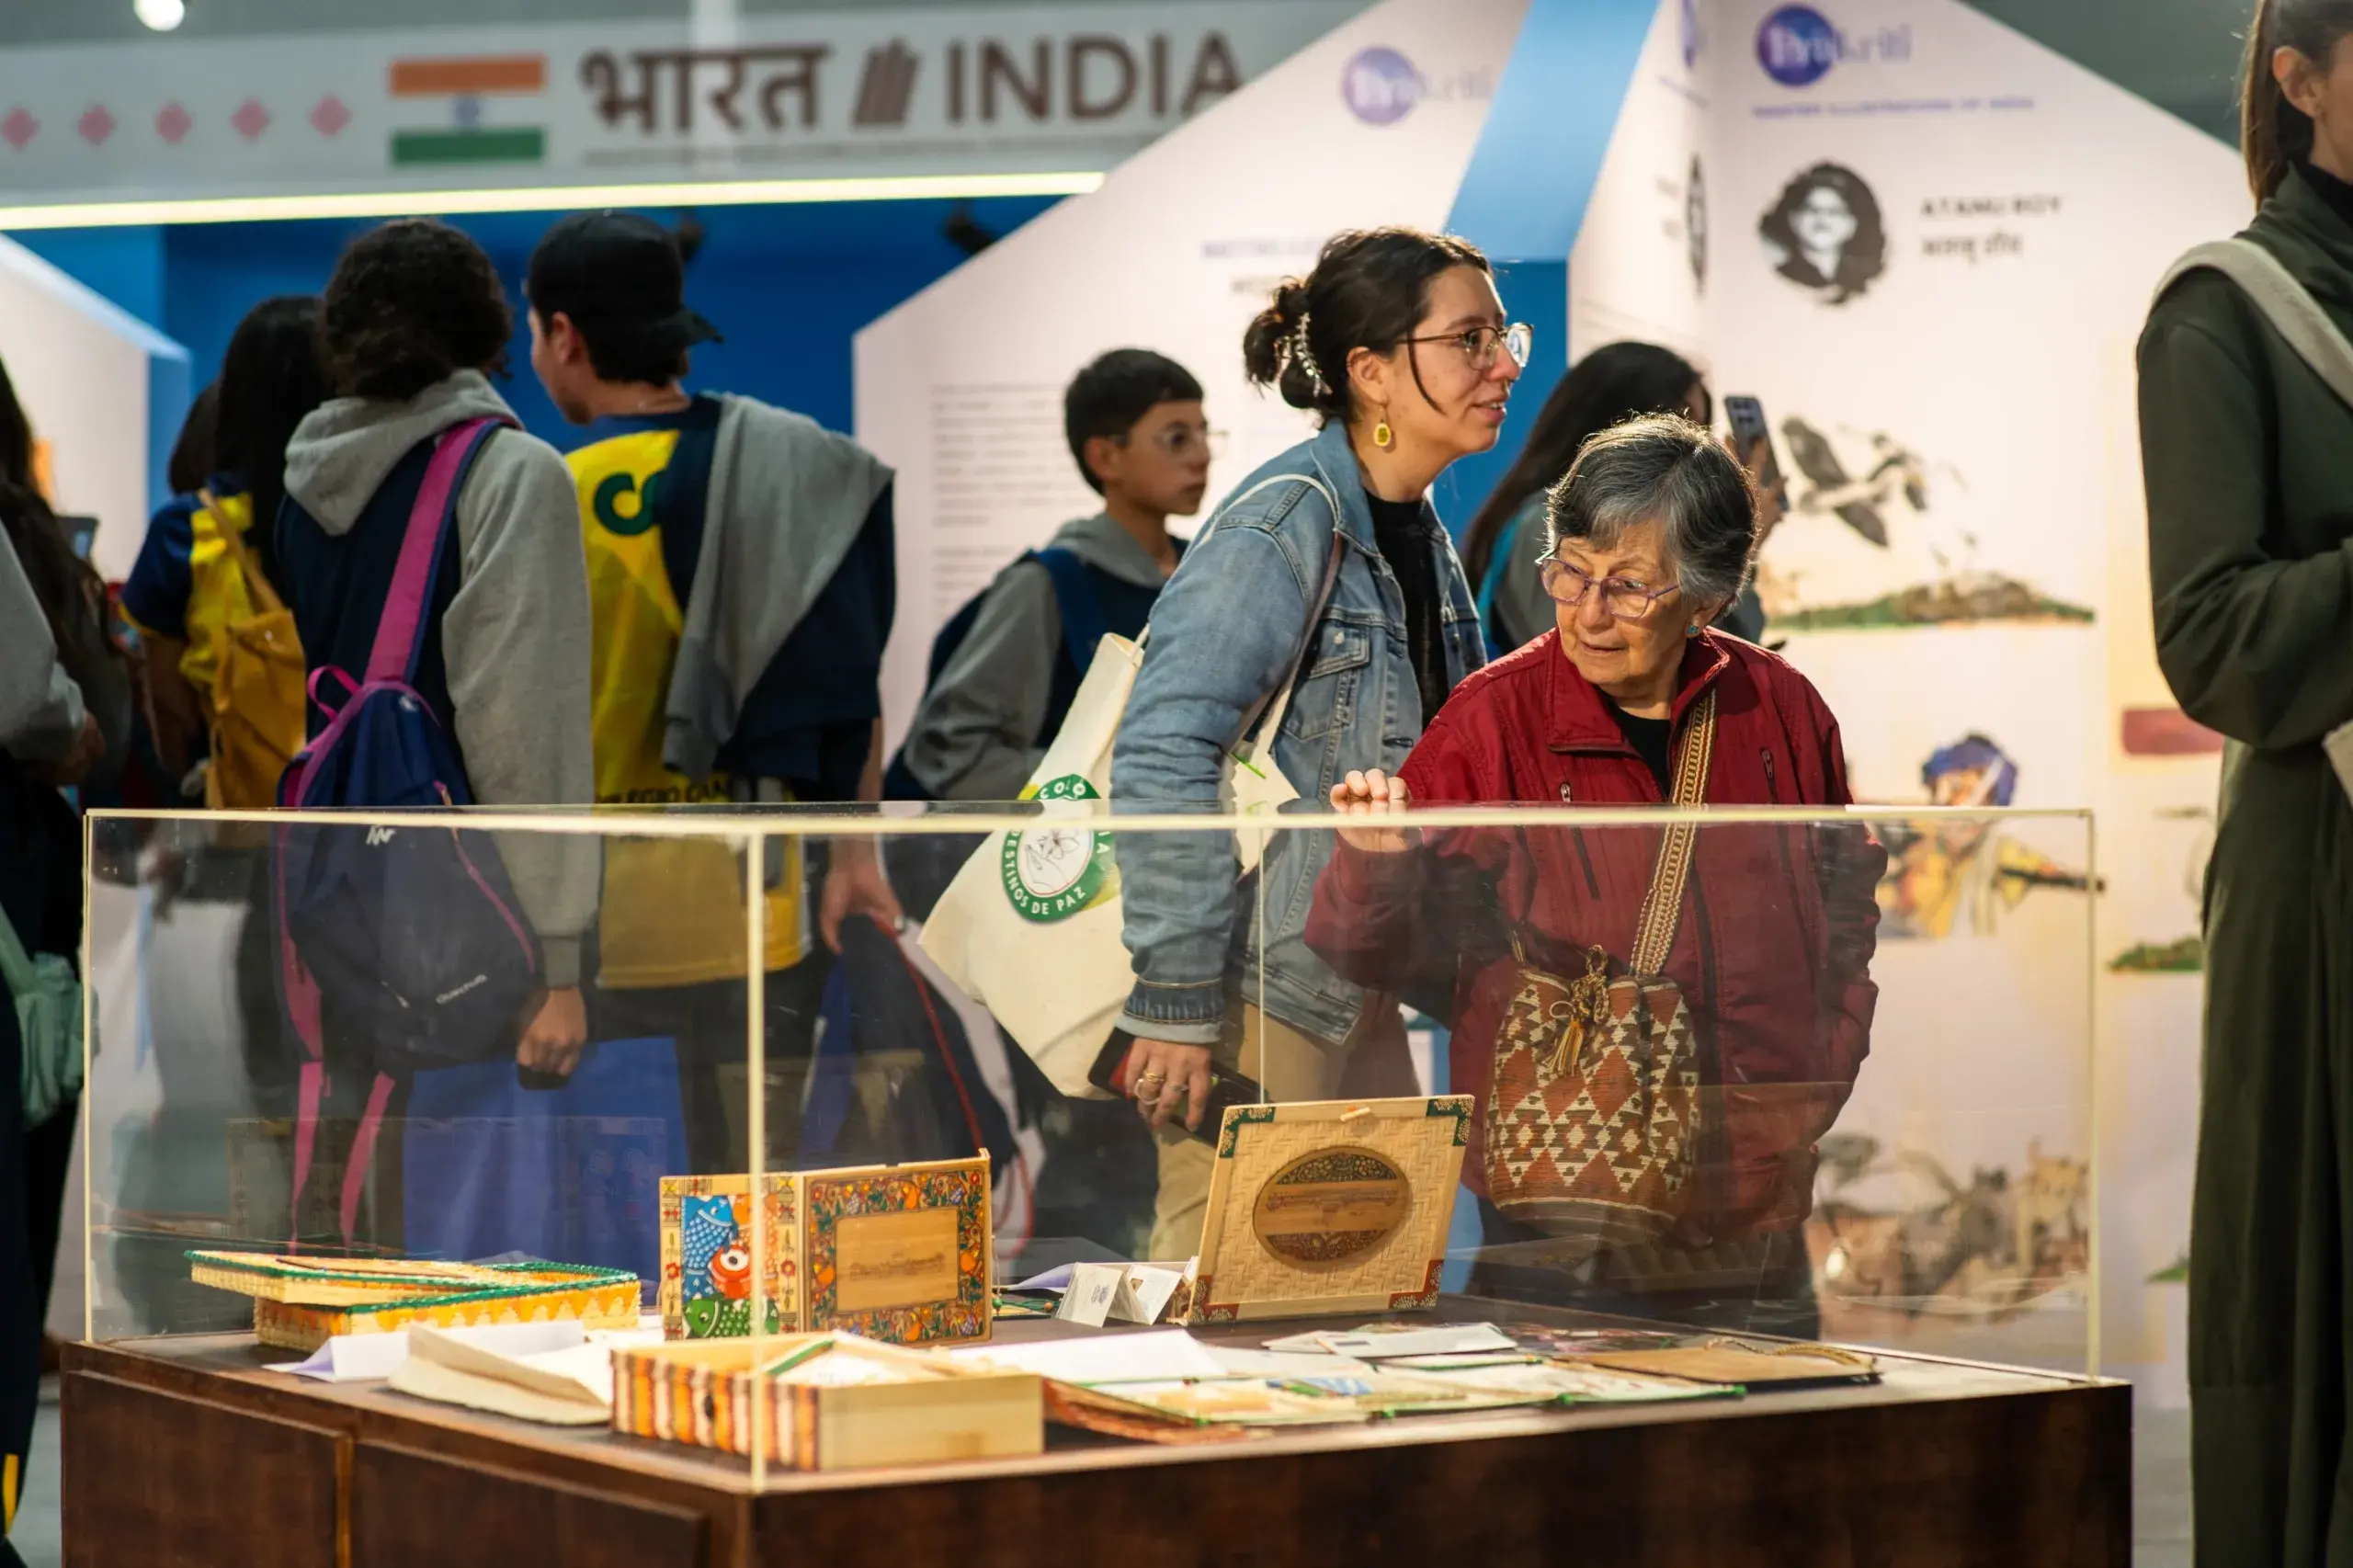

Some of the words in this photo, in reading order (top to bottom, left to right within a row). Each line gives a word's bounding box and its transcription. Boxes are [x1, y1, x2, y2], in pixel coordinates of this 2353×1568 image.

[578, 42, 833, 134] भारत
[947, 30, 1245, 123] INDIA
[1030, 901, 1050, 915] DE
[1056, 886, 1086, 912] PAZ
